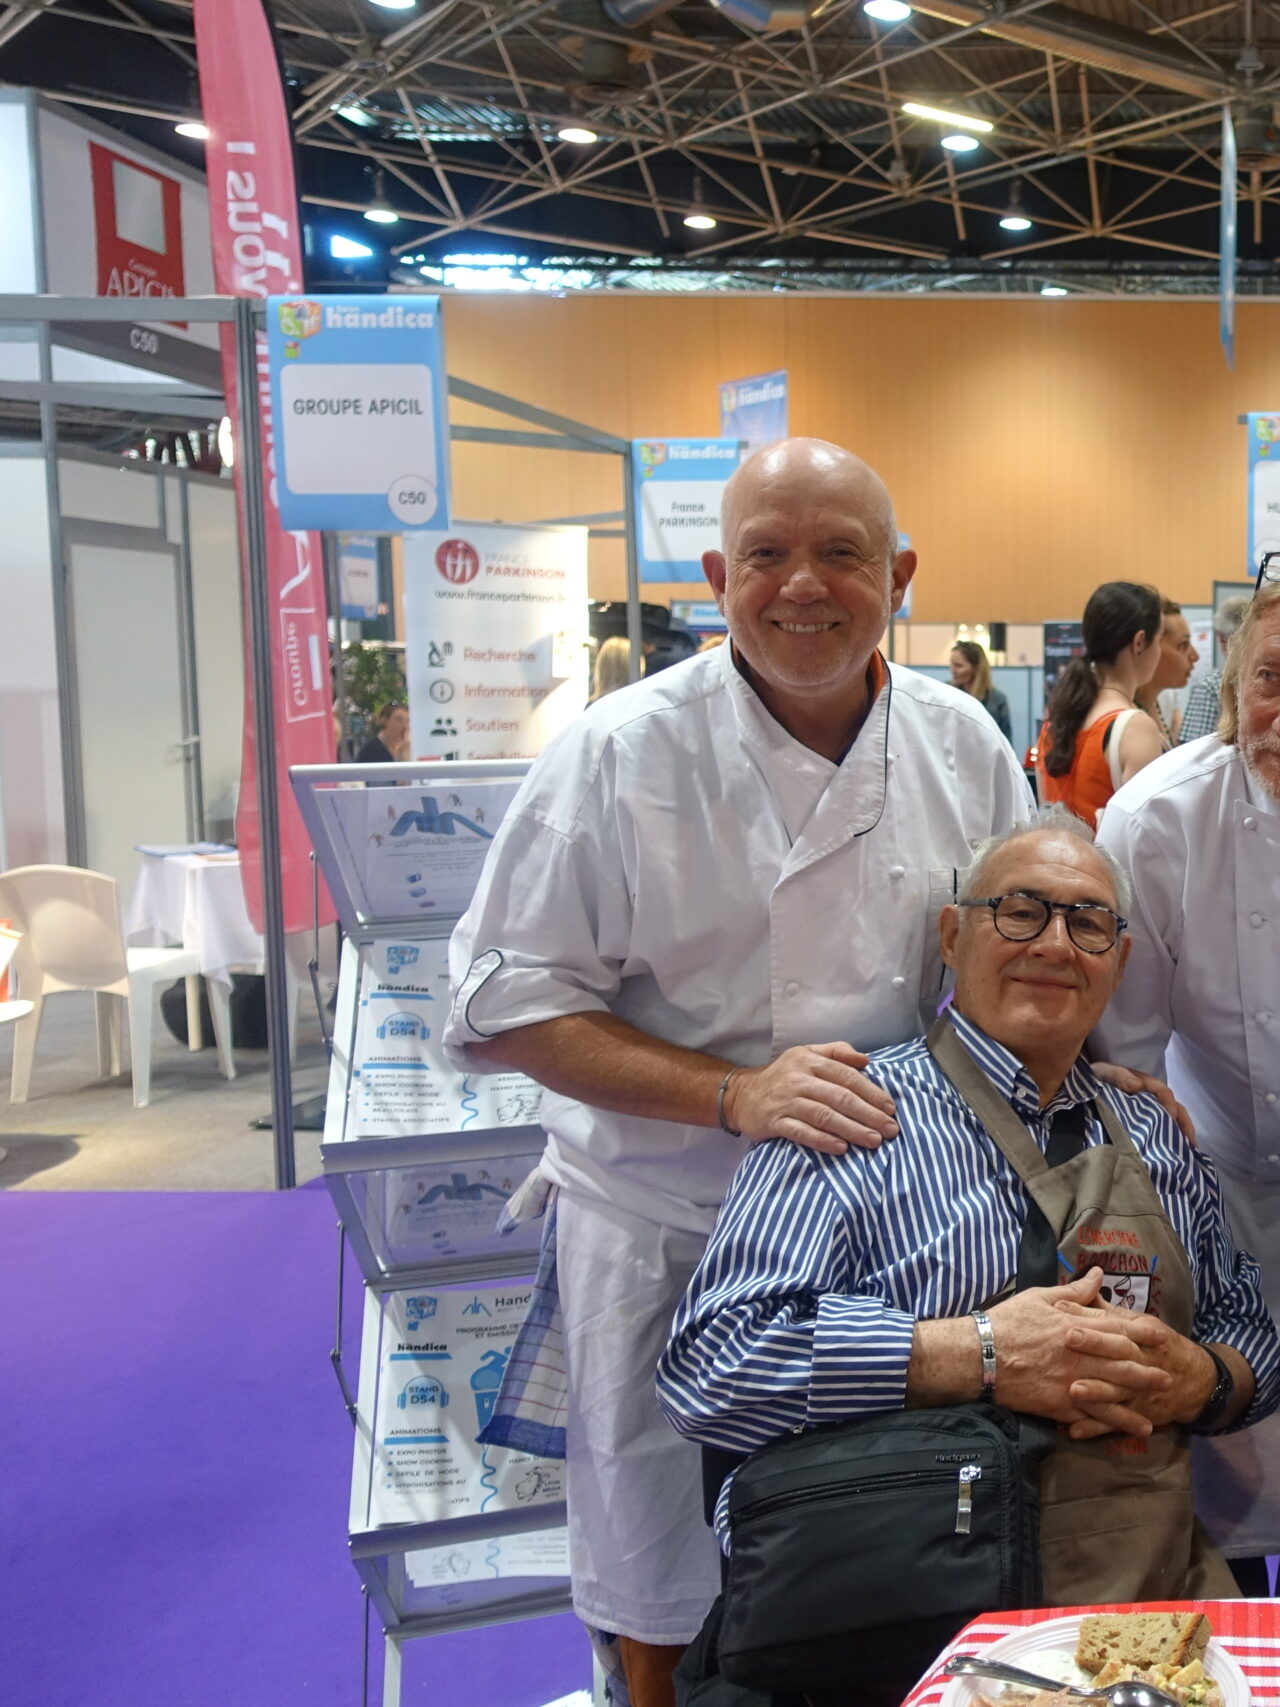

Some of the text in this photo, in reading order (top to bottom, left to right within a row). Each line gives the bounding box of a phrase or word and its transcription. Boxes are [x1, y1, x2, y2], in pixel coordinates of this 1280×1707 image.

[293, 399, 423, 415] GROUPE APICIL
[398, 492, 427, 505] C50
[671, 502, 705, 513] France
[658, 517, 719, 528] PARKINSON
[485, 566, 566, 579] PARKINSON
[463, 648, 536, 662] Recherche
[464, 684, 547, 698] Information
[466, 718, 519, 732] Soutien
[390, 1028, 417, 1036] D54
[1076, 1251, 1149, 1272] BOUCHON
[456, 1325, 507, 1334] PROGRAMME
[410, 1395, 436, 1404] D54
[390, 1427, 442, 1435] ANIMATIONS
